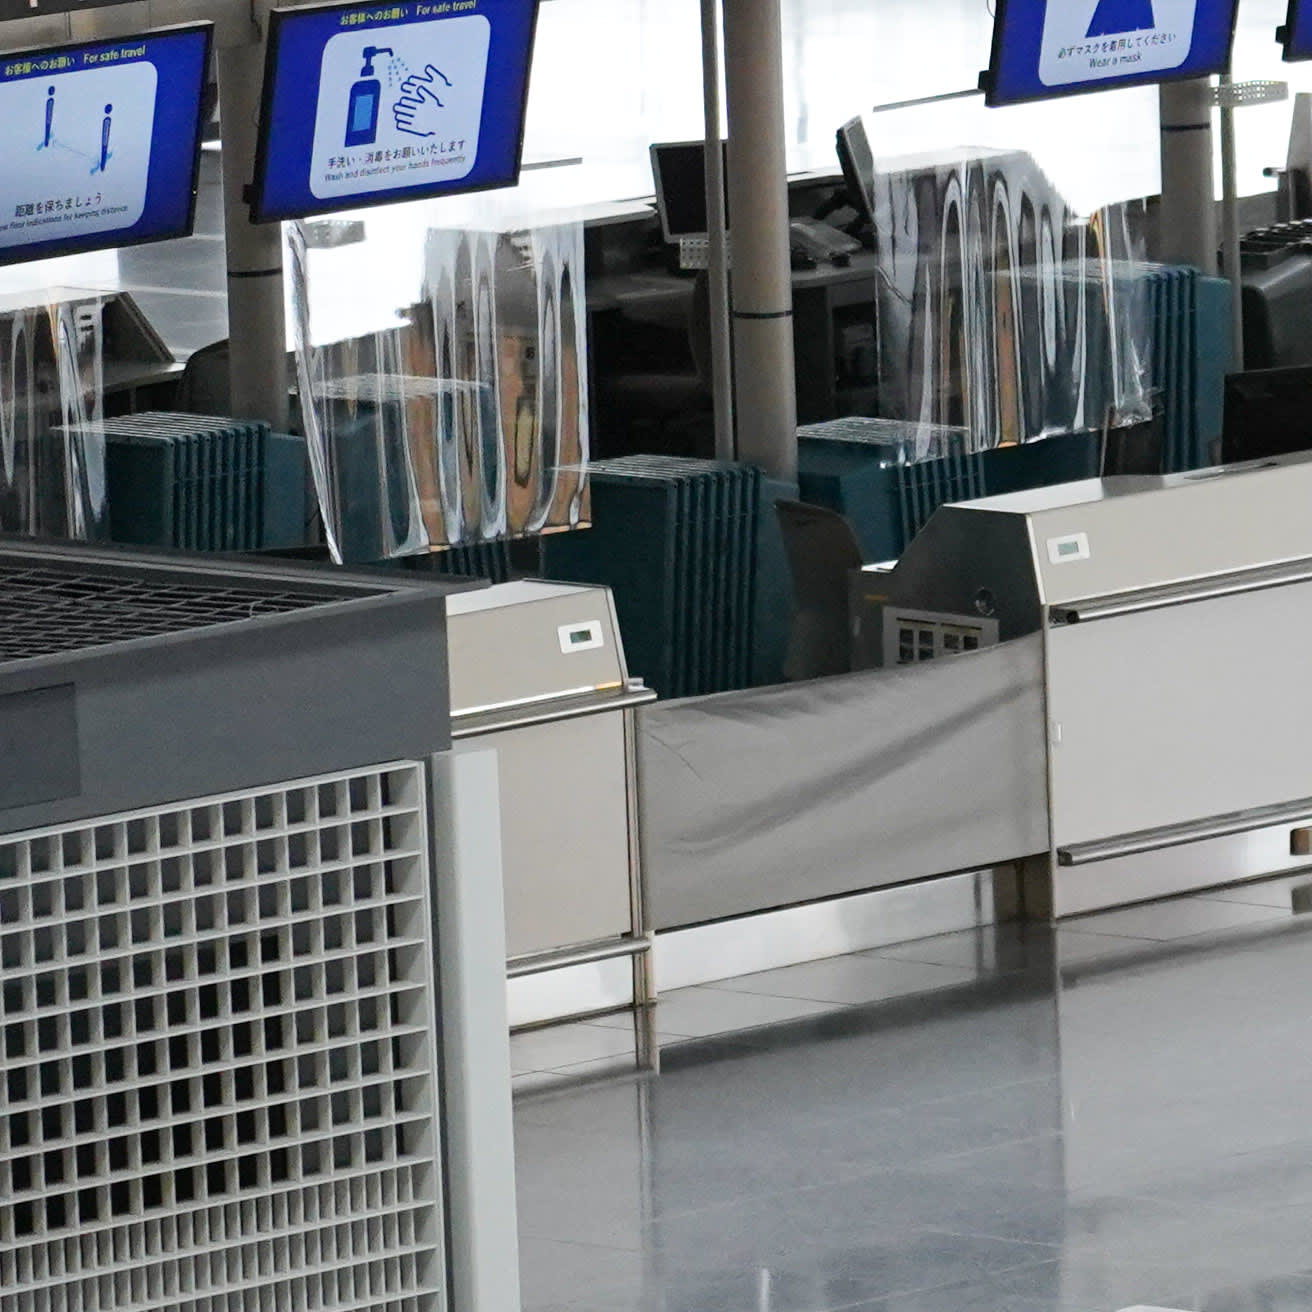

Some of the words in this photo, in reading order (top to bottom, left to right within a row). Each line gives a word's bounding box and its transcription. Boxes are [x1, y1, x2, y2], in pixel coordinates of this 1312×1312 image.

[340, 8, 408, 25] お客様へのお願い
[416, 5, 430, 16] For
[432, 3, 451, 14] safe
[452, 0, 477, 11] travel
[84, 53, 98, 64] For
[100, 50, 119, 62] safe
[121, 45, 146, 58] travel
[1058, 32, 1176, 59] 必ずマスクを着用してください
[5, 56, 75, 76] お客様へのお願い
[1089, 57, 1109, 68] Wear
[1120, 52, 1142, 63] mask
